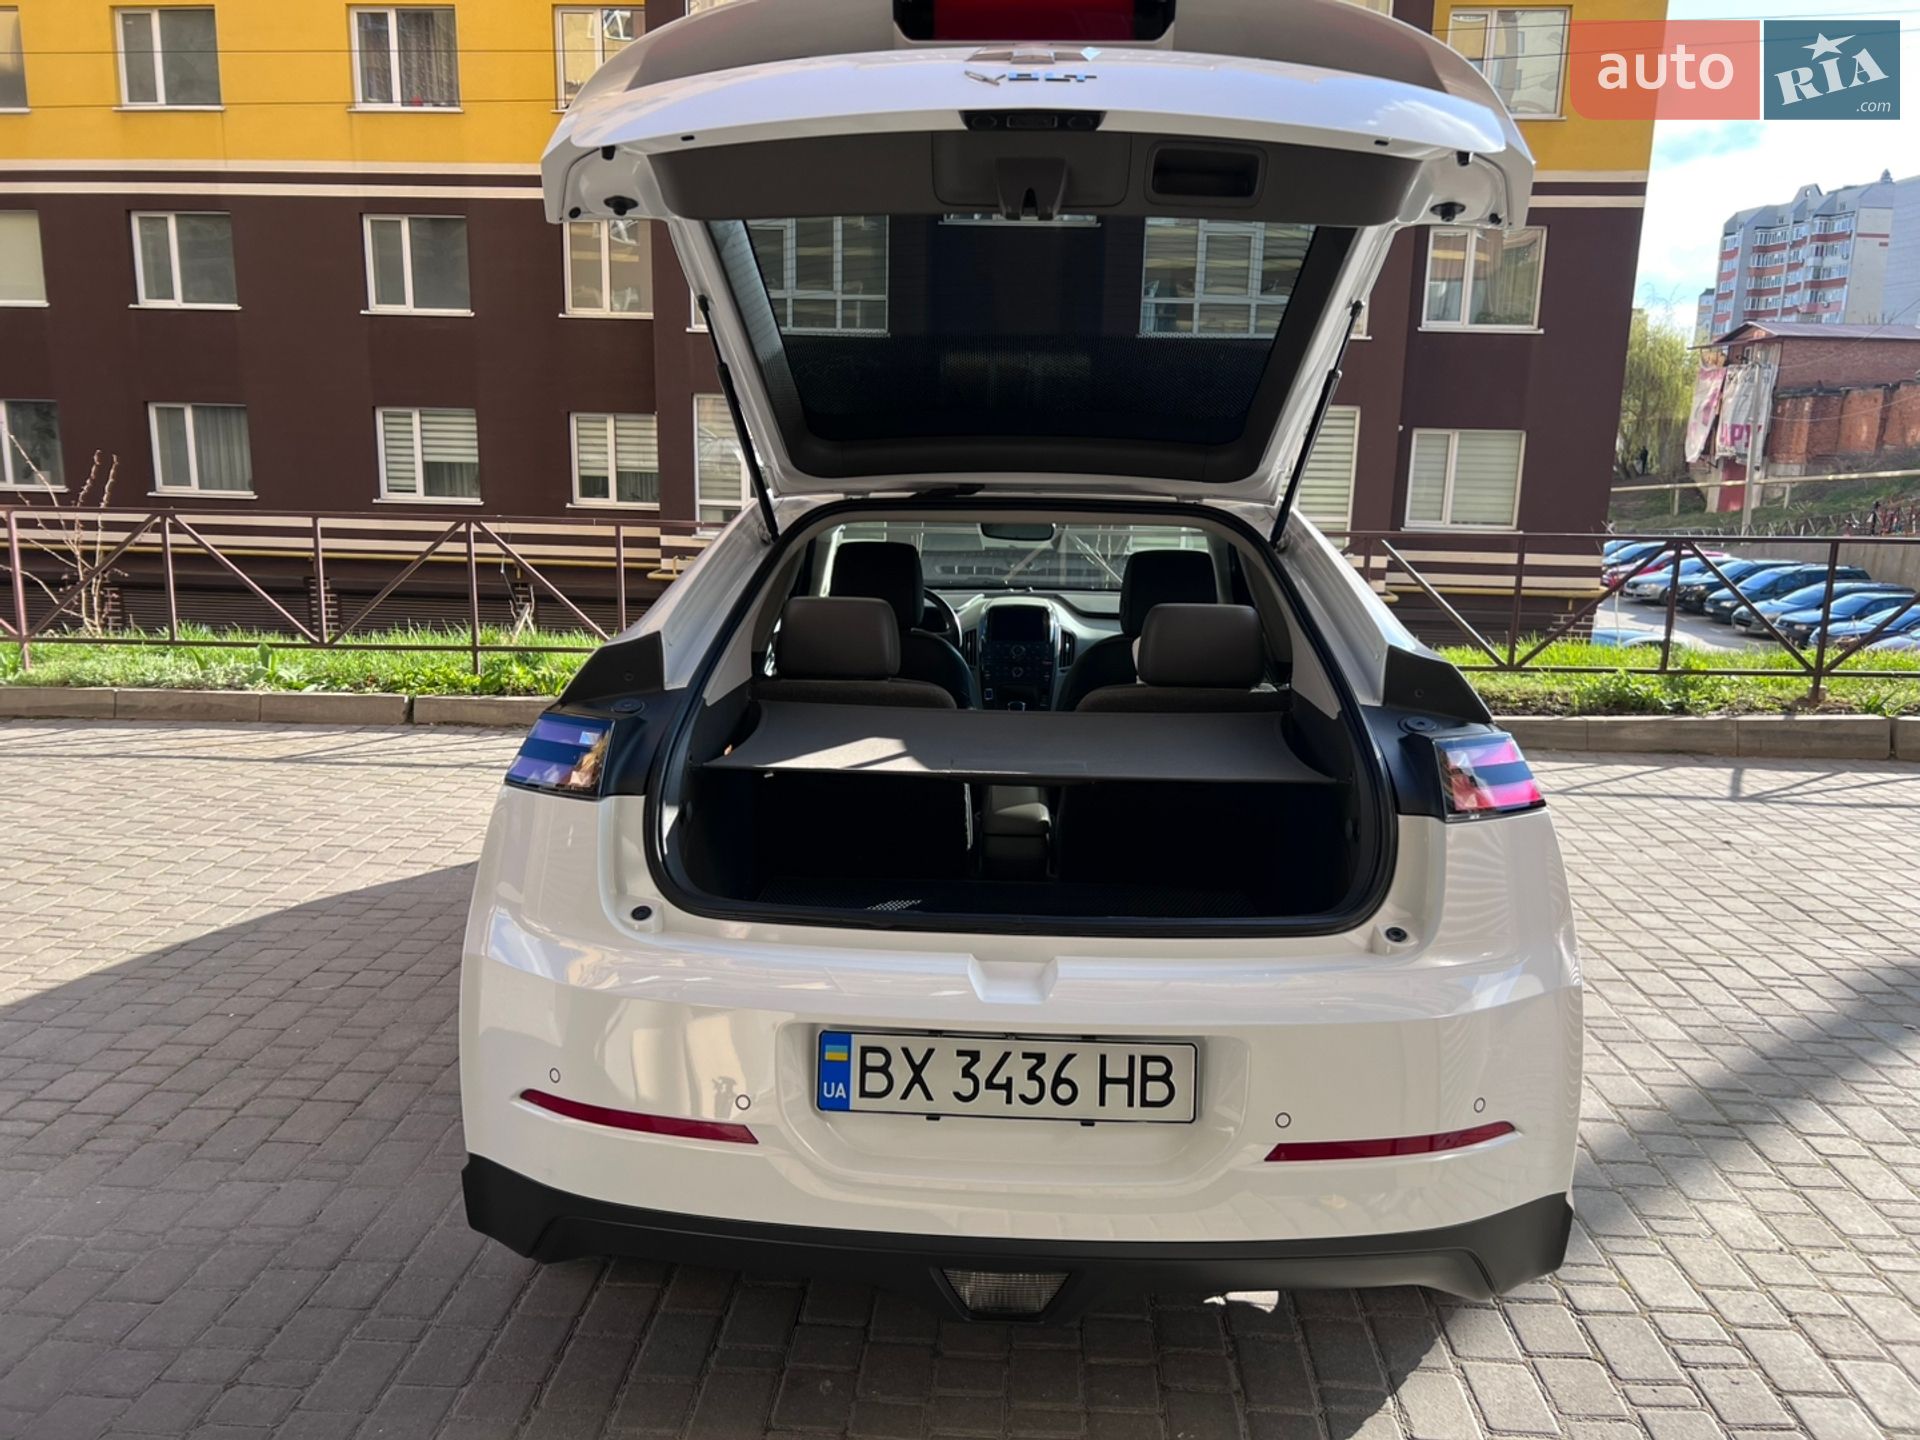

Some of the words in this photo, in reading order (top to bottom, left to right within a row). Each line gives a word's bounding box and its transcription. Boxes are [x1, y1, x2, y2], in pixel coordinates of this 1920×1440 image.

[823, 1082, 847, 1099] UA
[858, 1045, 936, 1101] BX
[952, 1049, 1079, 1106] 3436
[1099, 1053, 1176, 1108] HB
